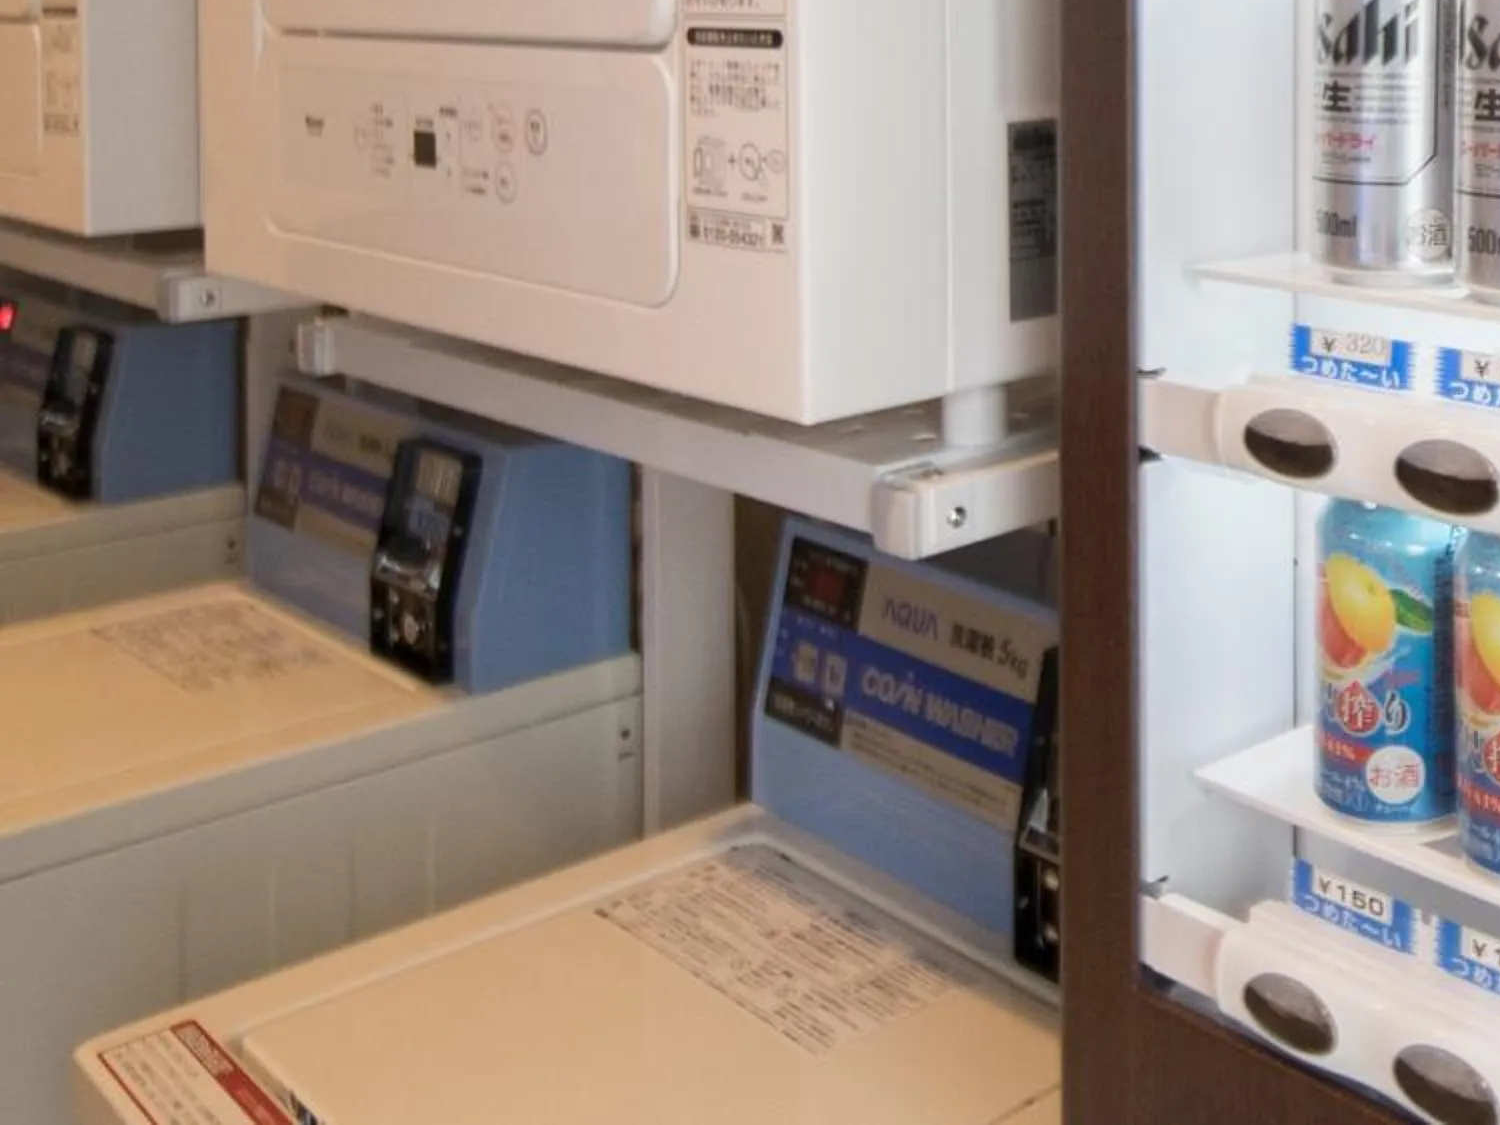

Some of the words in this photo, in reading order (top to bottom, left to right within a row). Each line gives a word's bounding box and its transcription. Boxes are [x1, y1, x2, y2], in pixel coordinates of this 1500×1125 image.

[1321, 80, 1353, 113] 生
[883, 597, 939, 642] AQUA
[861, 664, 925, 717] COIN
[925, 689, 1021, 760] WASHER
[1367, 761, 1421, 791] お酒
[1317, 877, 1386, 919] ¥150
